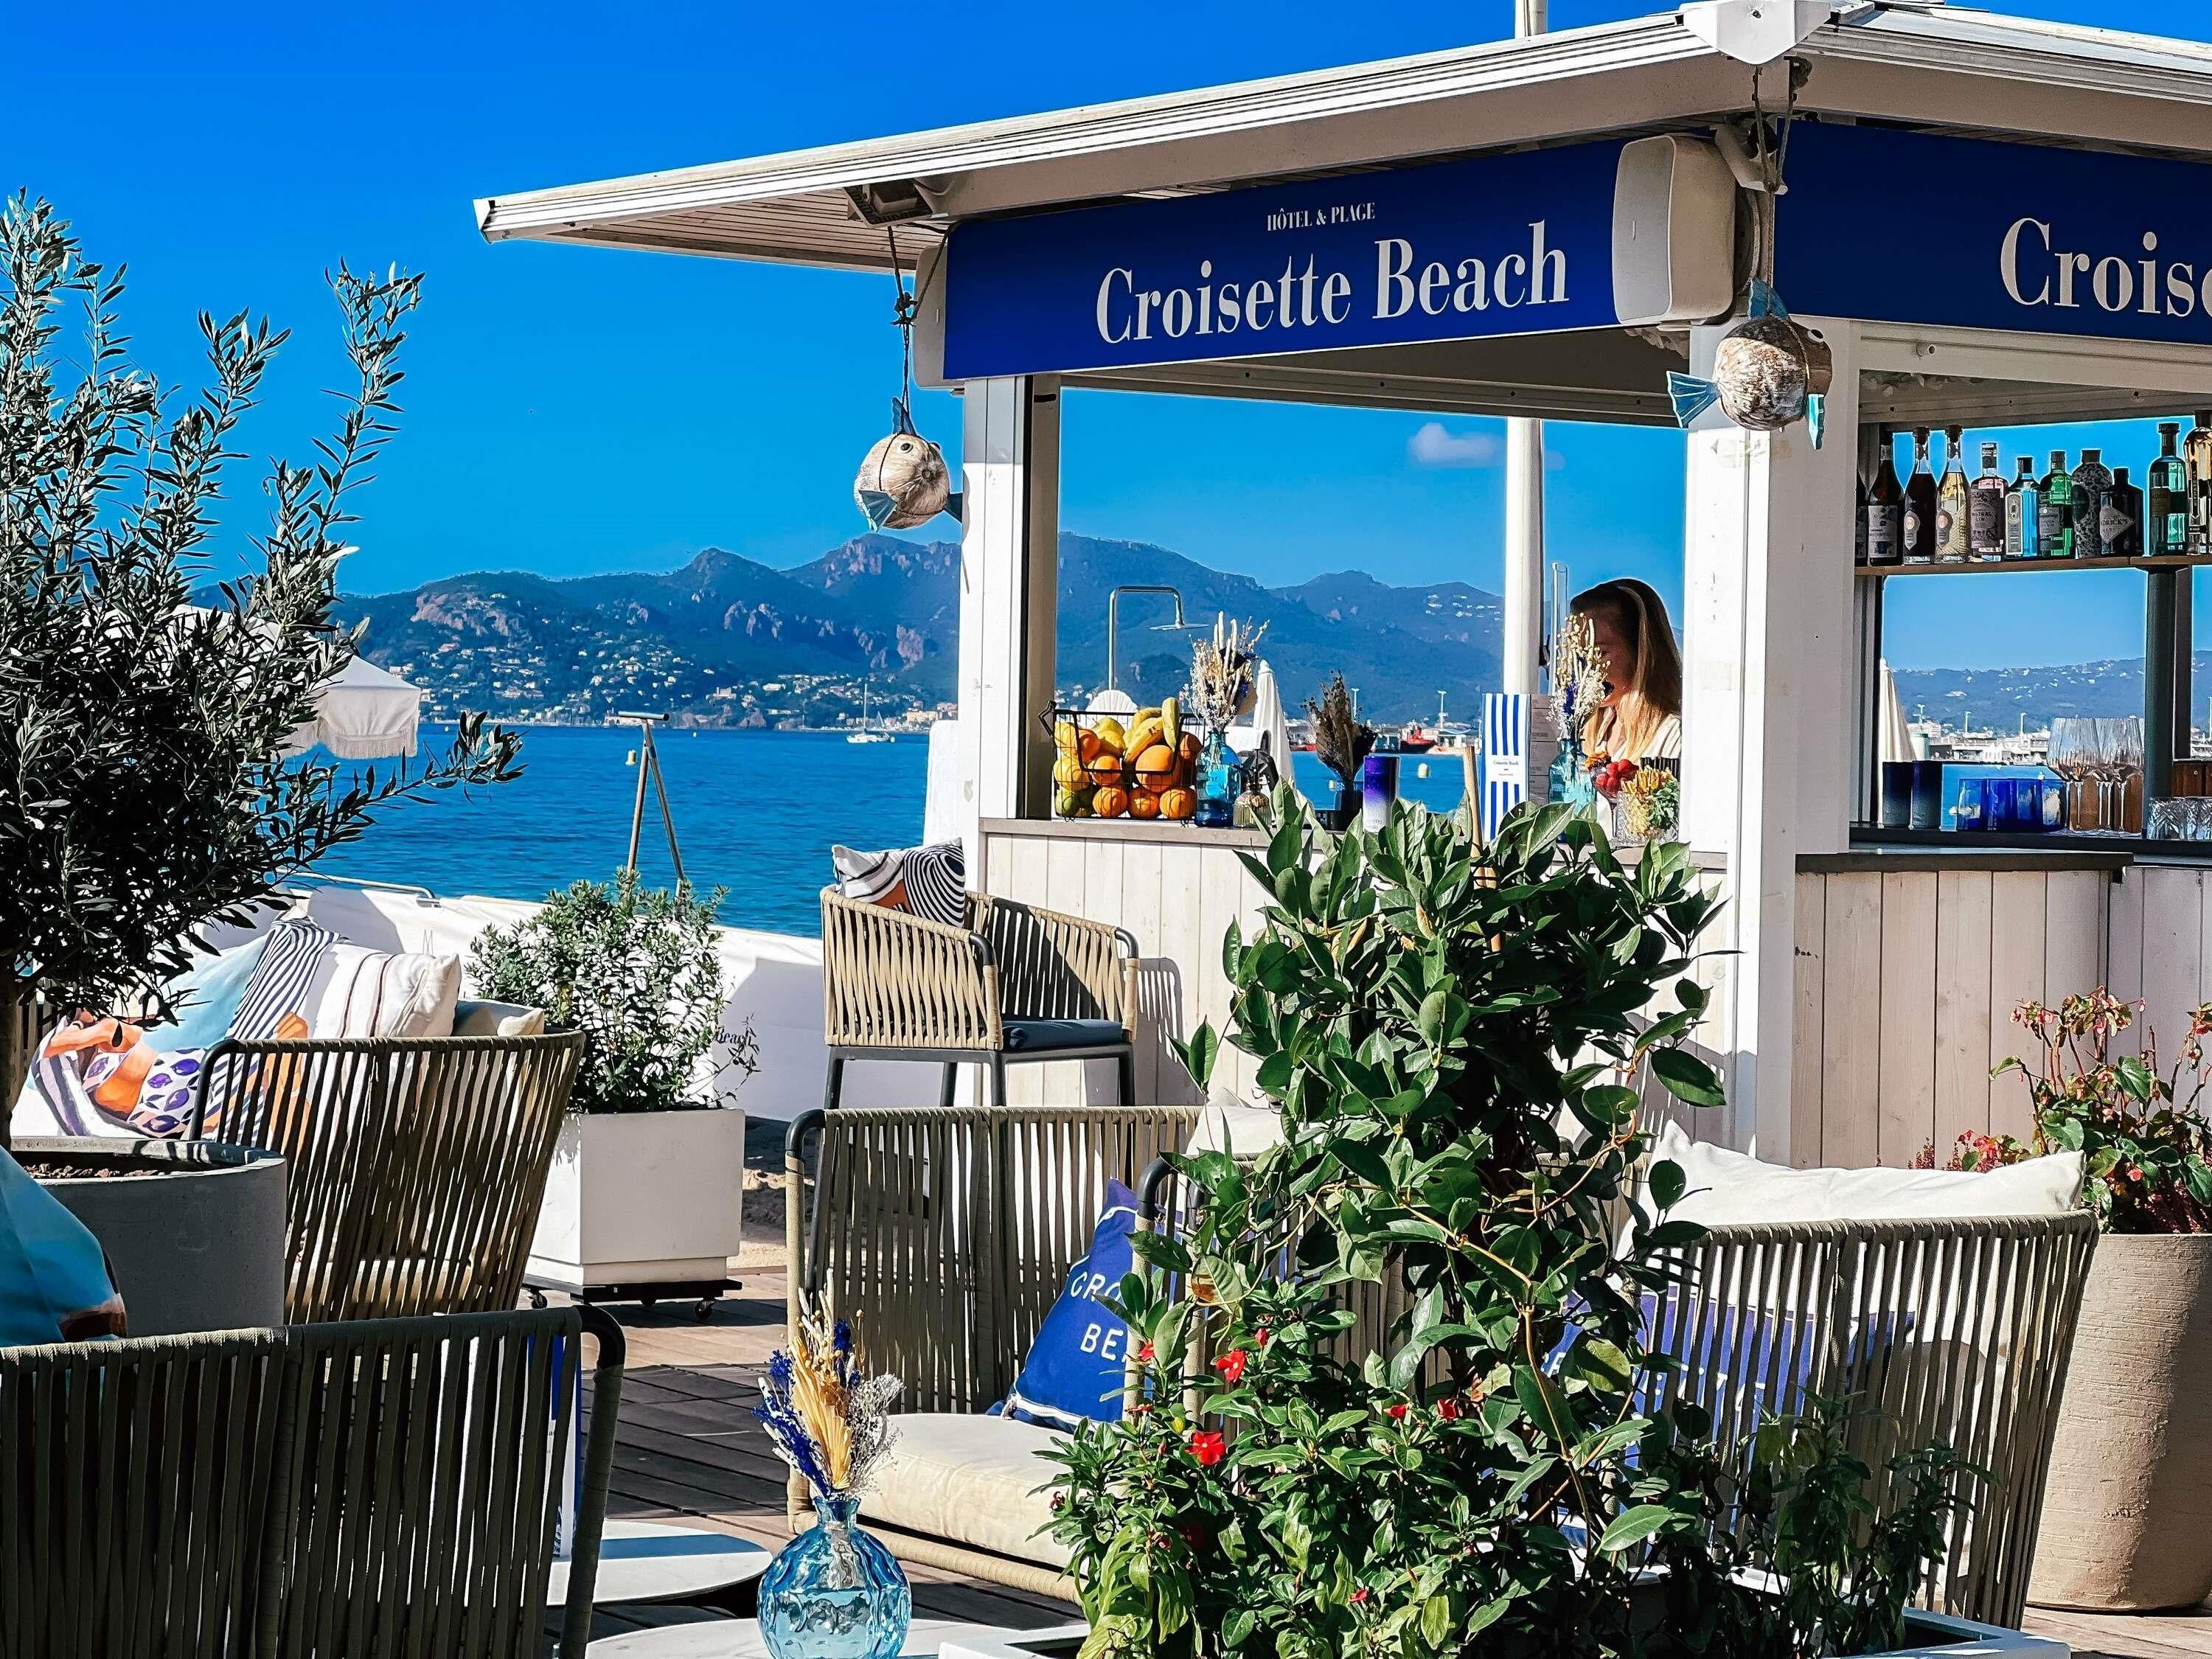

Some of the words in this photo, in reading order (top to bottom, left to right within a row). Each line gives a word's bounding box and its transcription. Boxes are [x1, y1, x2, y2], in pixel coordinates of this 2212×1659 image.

[1267, 207, 1312, 232] HÔTEL
[1316, 209, 1326, 226] &
[1331, 202, 1375, 224] PLAGE
[1096, 254, 1352, 344] Croisette
[1371, 219, 1570, 319] Beach
